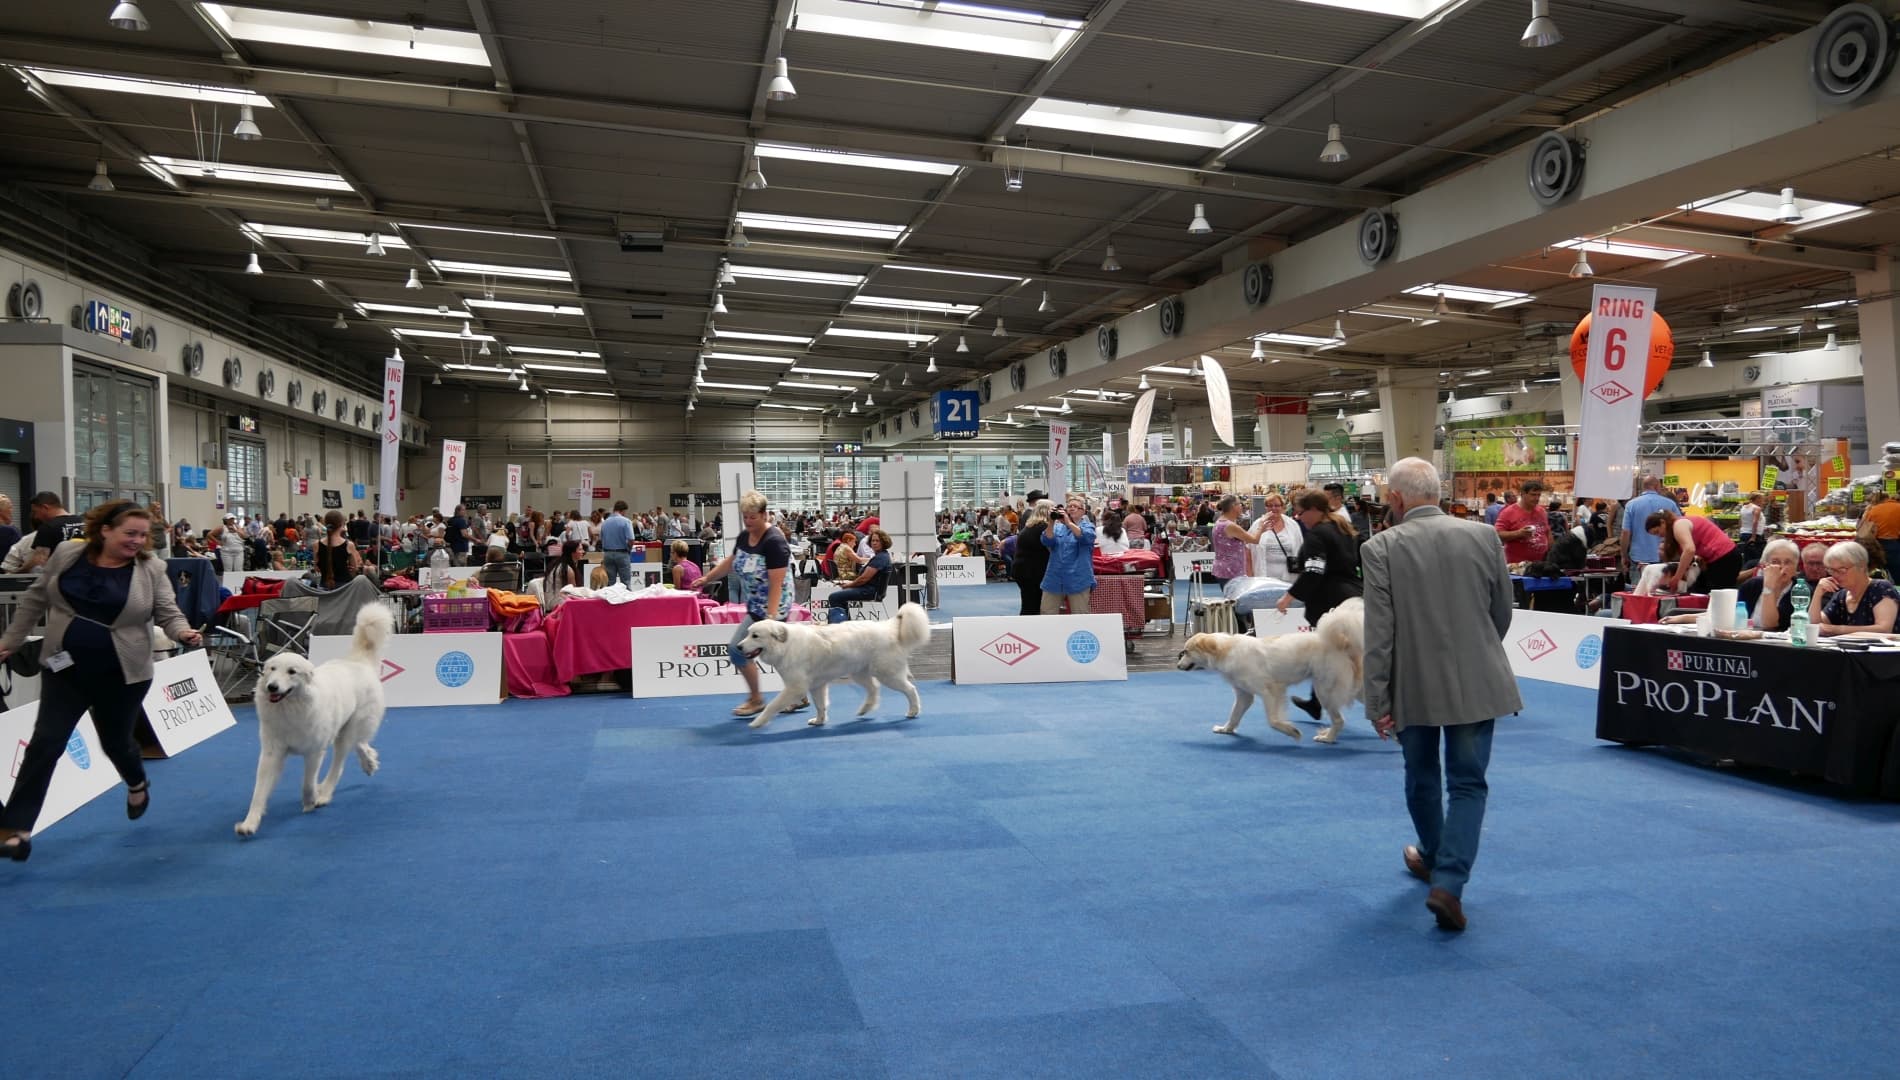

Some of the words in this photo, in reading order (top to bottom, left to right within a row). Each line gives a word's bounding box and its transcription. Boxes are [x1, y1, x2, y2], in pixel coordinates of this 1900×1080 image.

[1598, 297, 1644, 319] RING
[121, 315, 131, 334] 22
[1604, 327, 1628, 371] 6
[1600, 387, 1621, 397] VDH
[388, 389, 396, 421] 5
[946, 398, 972, 421] 21
[1051, 424, 1067, 435] RING
[445, 444, 462, 453] RING
[1055, 438, 1062, 456] 7
[448, 455, 456, 471] 8
[511, 474, 517, 486] 9
[582, 479, 591, 489] 11
[700, 645, 728, 656] PUR
[995, 643, 1022, 654] VDH
[1527, 638, 1546, 651] VDH
[1684, 654, 1747, 676] PURINA
[170, 679, 198, 700] PURINA
